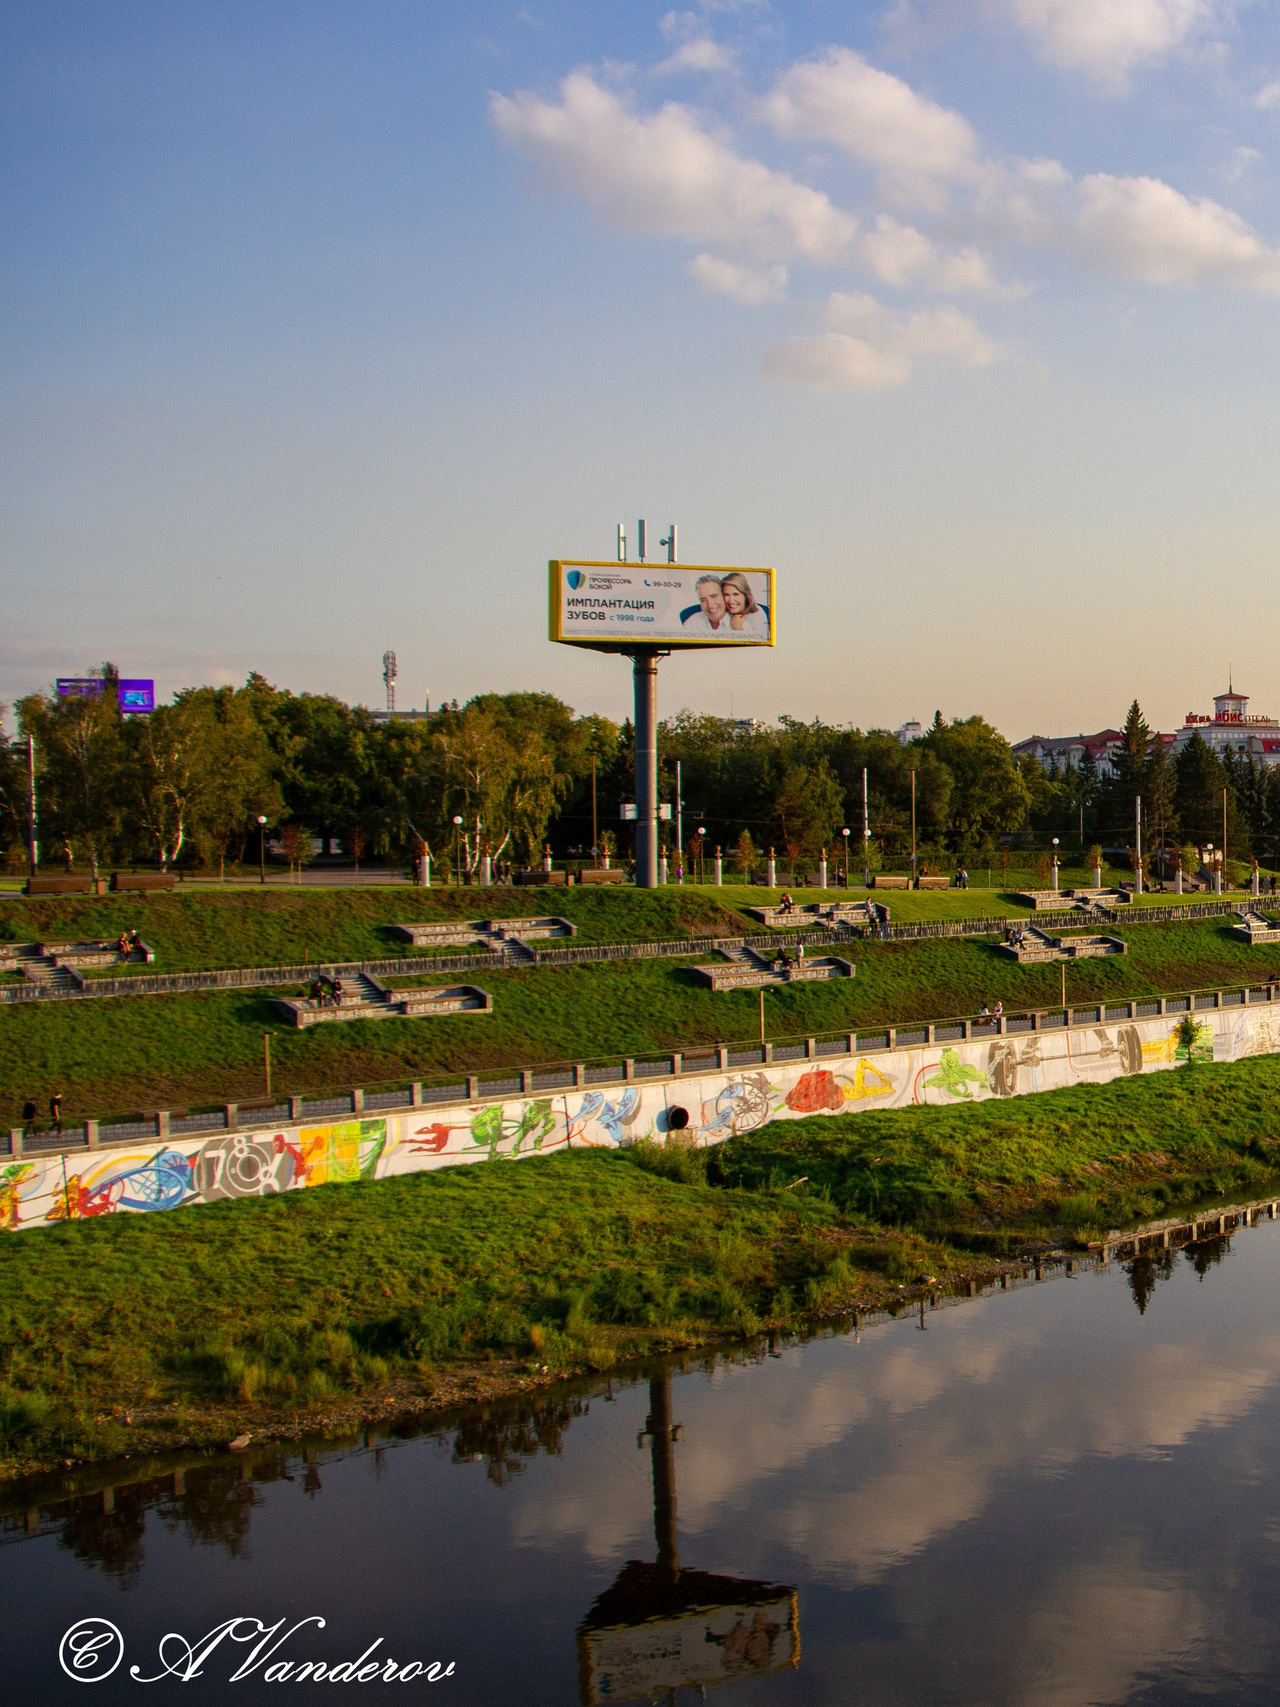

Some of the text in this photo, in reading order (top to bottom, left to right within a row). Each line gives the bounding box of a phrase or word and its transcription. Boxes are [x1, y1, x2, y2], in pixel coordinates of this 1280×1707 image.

[589, 577, 632, 585] ПРОФЕССОРА
[567, 598, 655, 610] ИМПЛАНТАЦИЯ
[567, 610, 606, 621] ЗУБОВ
[616, 614, 635, 622] 1998
[1215, 710, 1243, 723] ибис
[1245, 715, 1271, 723] ОТЕЛЬ
